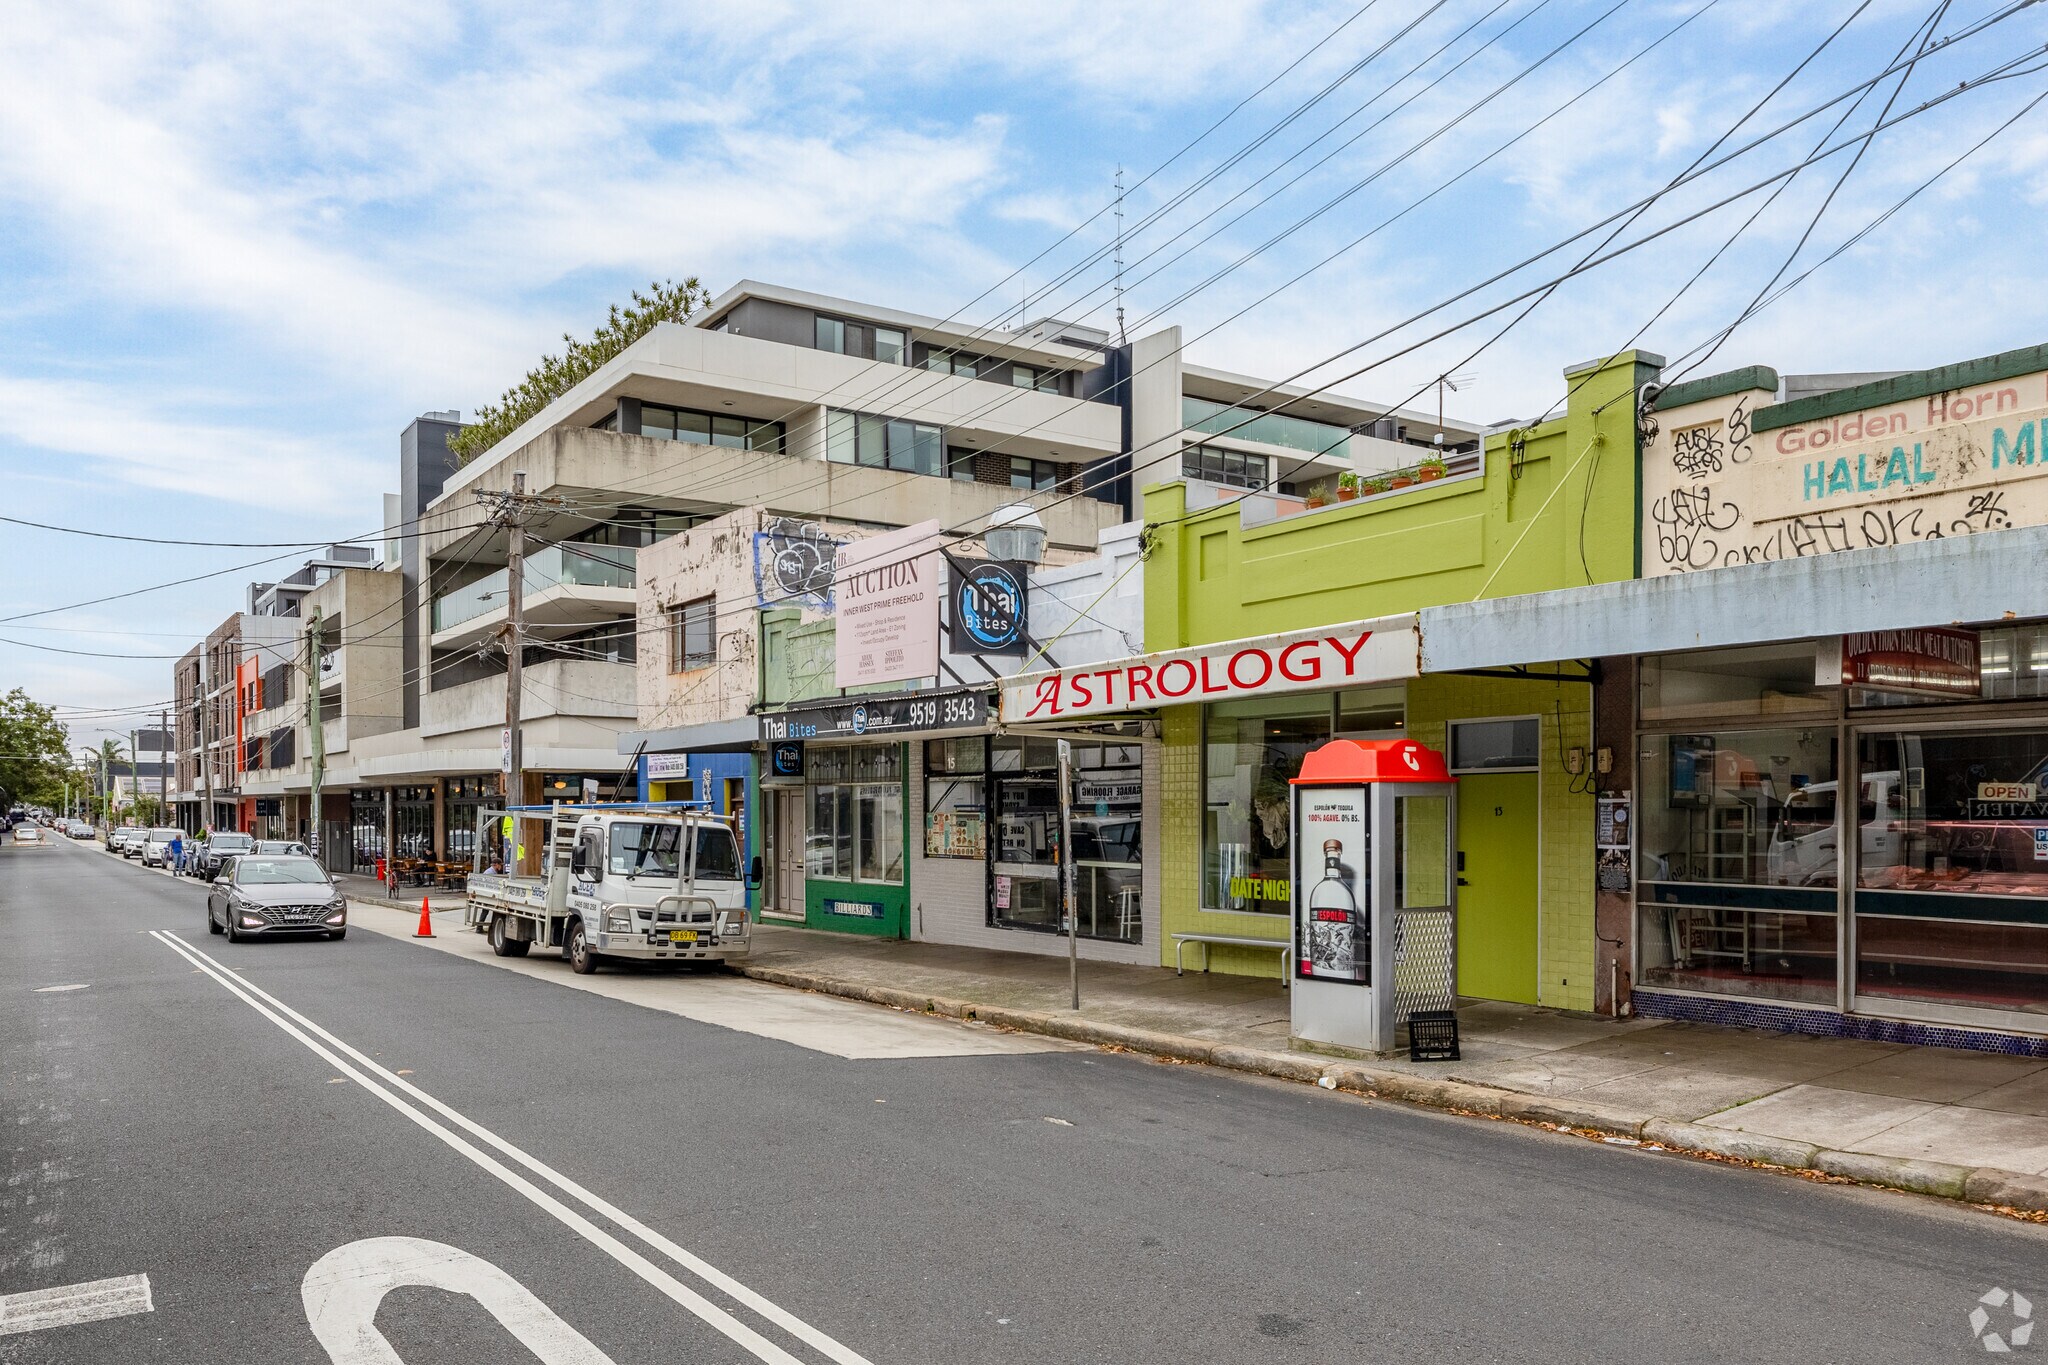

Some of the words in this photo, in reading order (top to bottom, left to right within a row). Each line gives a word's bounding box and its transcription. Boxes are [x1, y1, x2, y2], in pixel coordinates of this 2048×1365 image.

[1776, 412, 1907, 454] Golden
[1928, 388, 2018, 426] Horn
[1803, 442, 1936, 501] HALAL
[846, 557, 920, 600] AUCTION
[843, 604, 858, 617] INNER
[859, 604, 874, 614] WEST
[874, 598, 892, 610] PRIME
[892, 592, 924, 607] FREEHOLD
[967, 584, 1015, 614] Thai
[966, 615, 1008, 630] Bites
[1026, 631, 1373, 718] ASTROLOGY
[1857, 662, 1864, 678] 11
[910, 701, 936, 725] 9519
[944, 697, 976, 722] 3543
[763, 717, 787, 740] Thai
[790, 723, 817, 738] Bites
[836, 720, 852, 729] www.
[866, 716, 892, 726] .com.au
[777, 750, 798, 760] Thai
[1984, 786, 2028, 798] OPEN
[1494, 806, 1503, 816] 13
[1230, 877, 1261, 899] DATE
[834, 902, 872, 915] BILLIARDS
